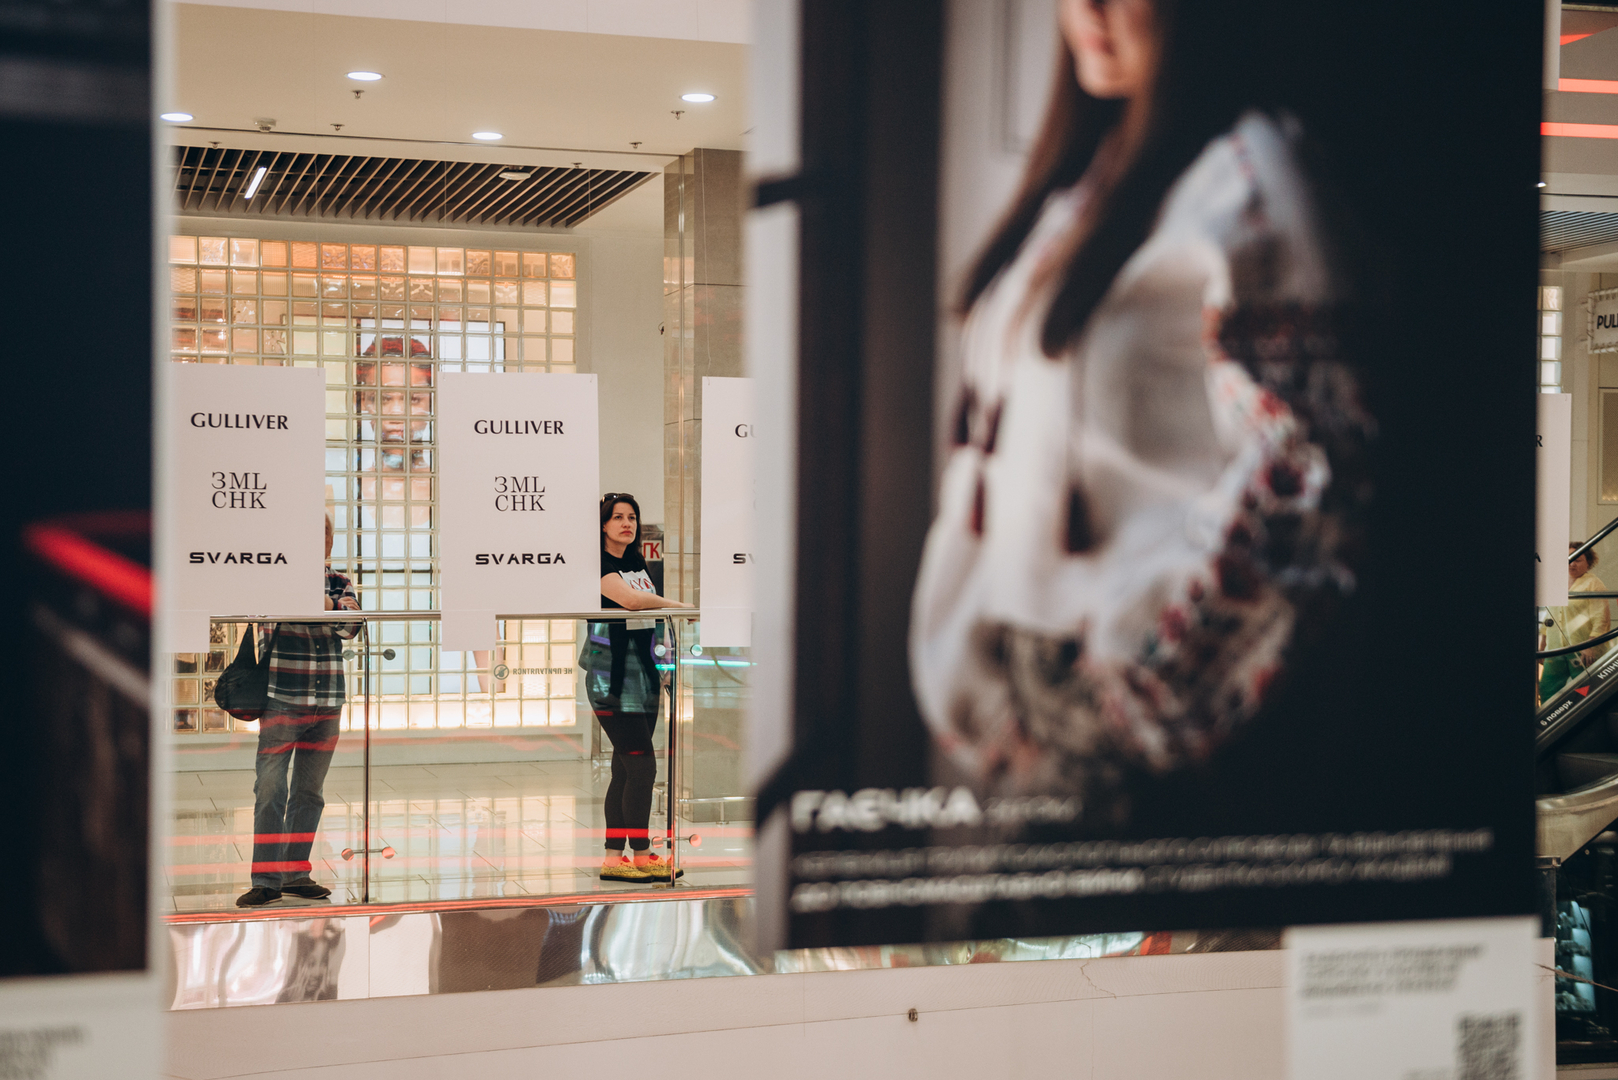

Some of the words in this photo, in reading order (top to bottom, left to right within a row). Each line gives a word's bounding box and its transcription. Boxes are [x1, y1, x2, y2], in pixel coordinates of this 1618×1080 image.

[1597, 313, 1618, 330] PUL
[190, 412, 289, 430] GULLIVER
[473, 419, 565, 435] GULLIVER
[211, 490, 267, 509] CHK
[494, 494, 546, 512] CHK
[189, 552, 288, 564] SVARGA
[475, 553, 566, 565] SVARGA
[1546, 700, 1573, 722] поверх
